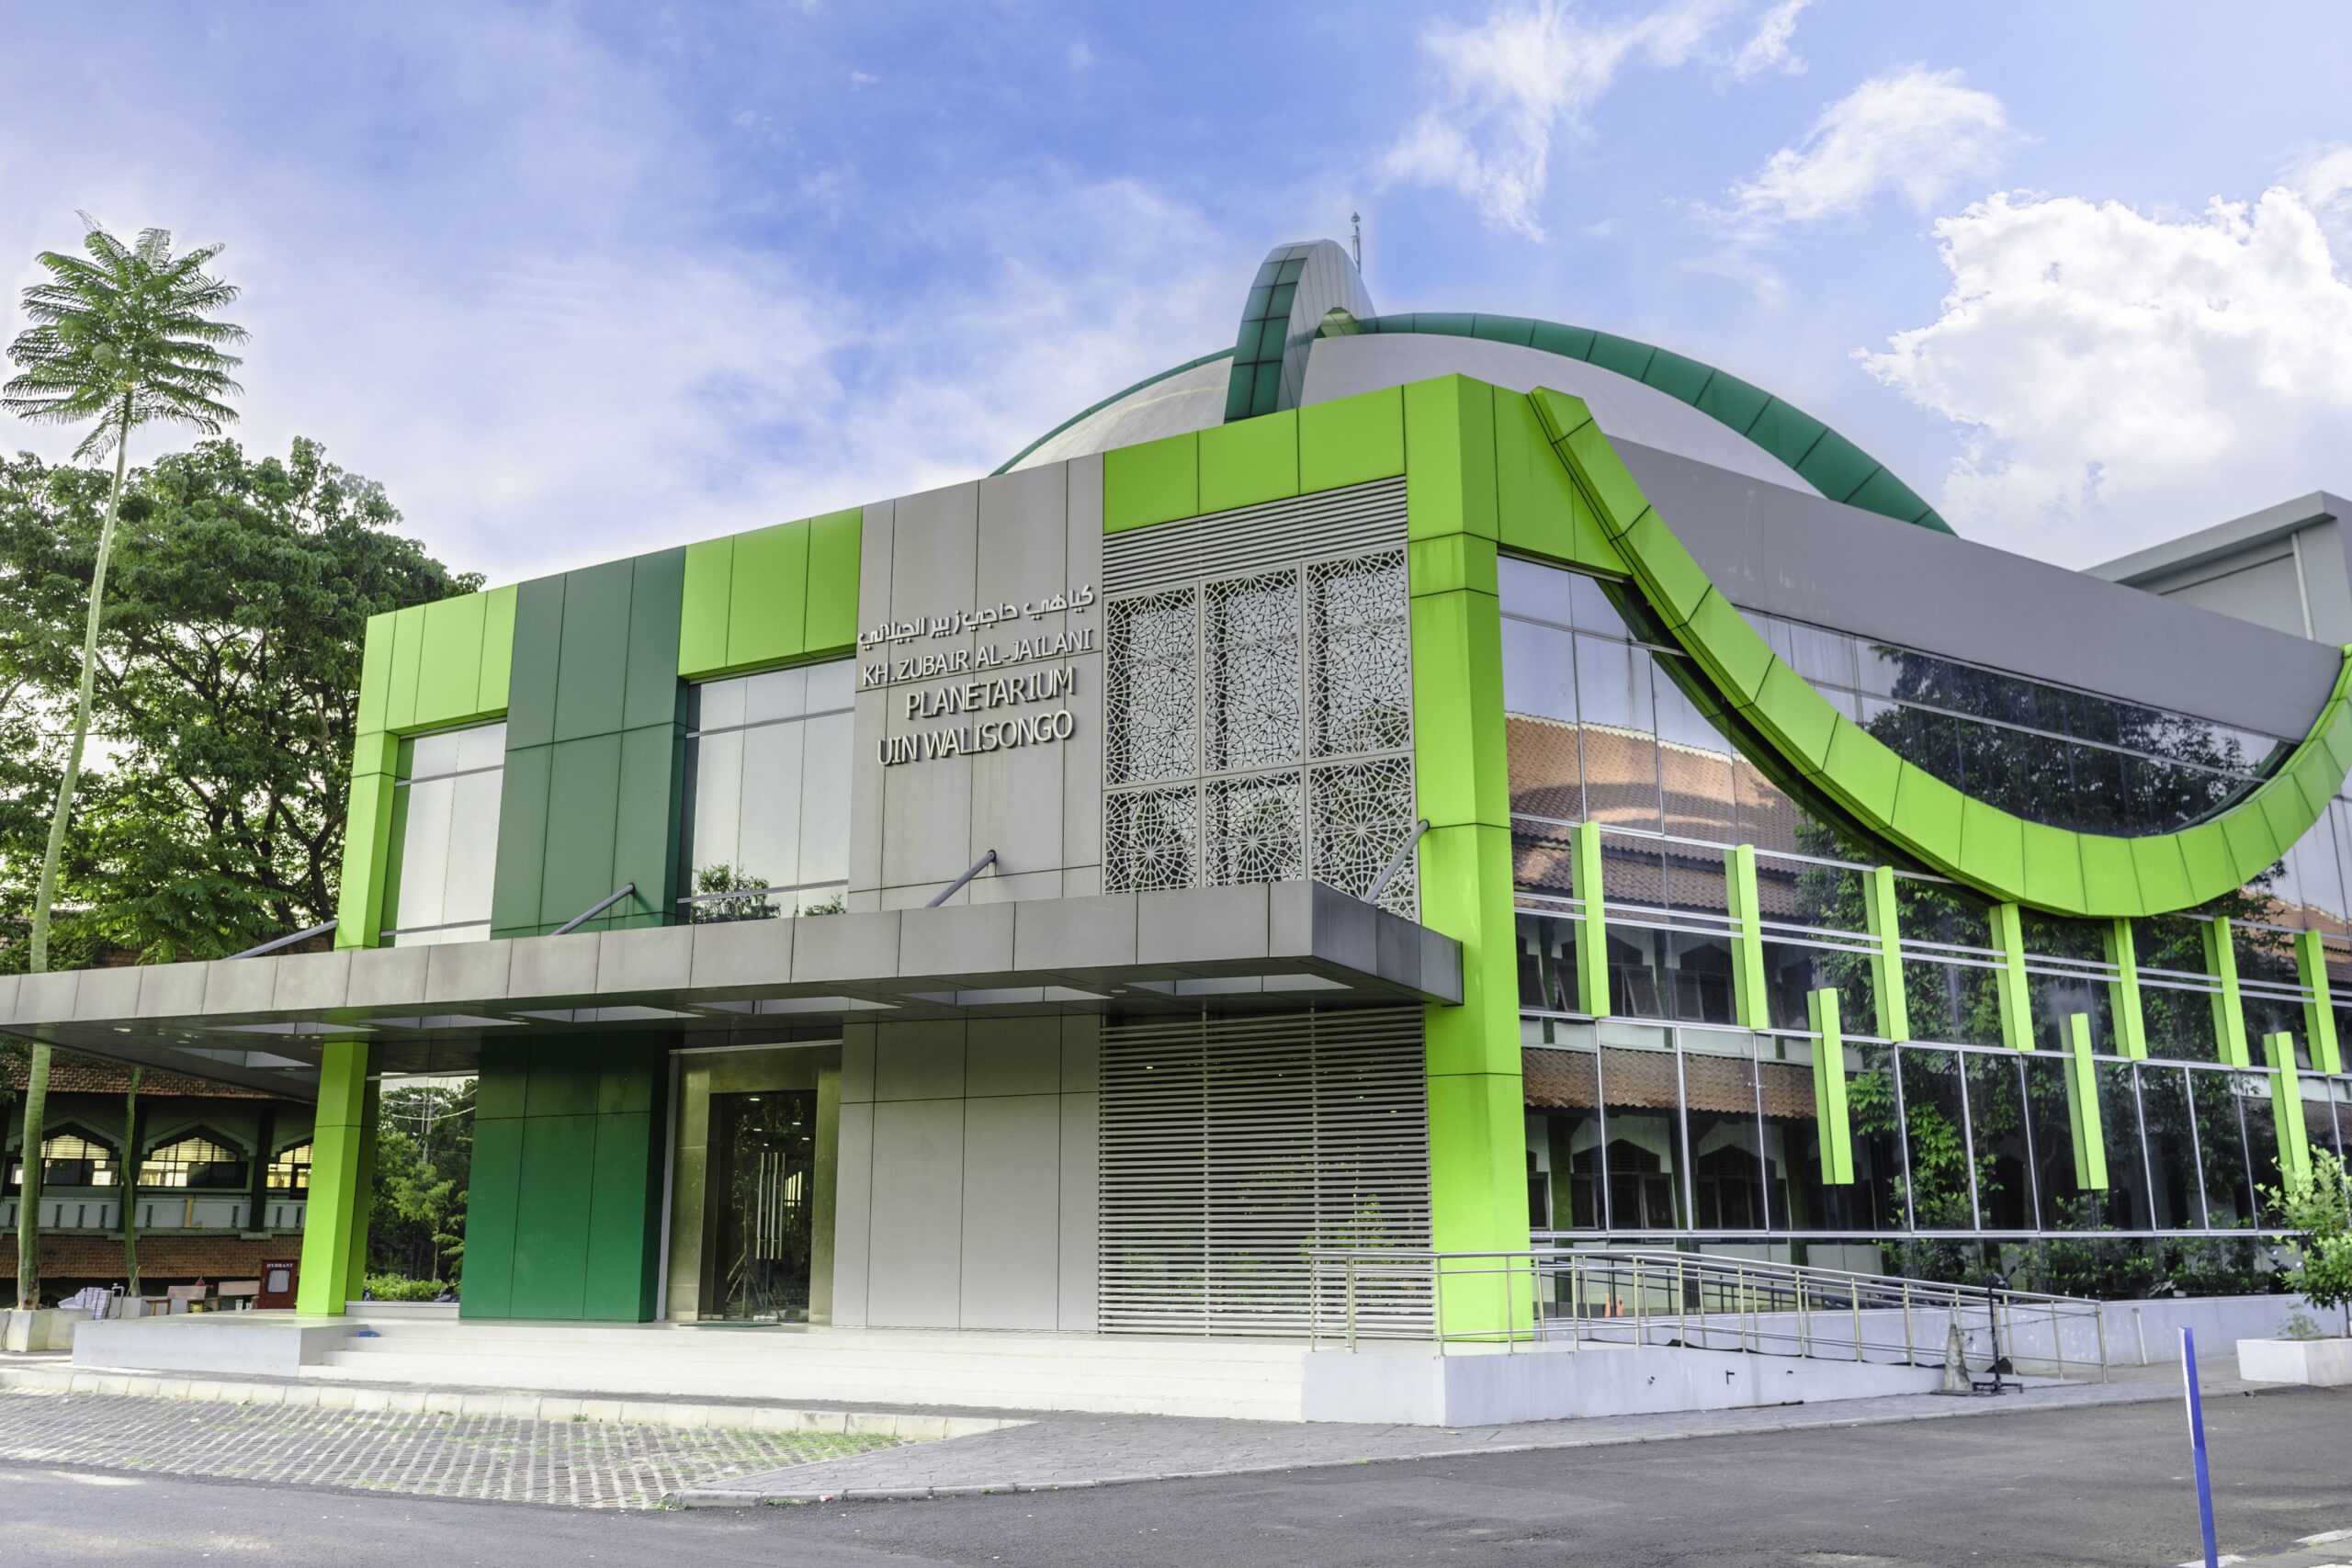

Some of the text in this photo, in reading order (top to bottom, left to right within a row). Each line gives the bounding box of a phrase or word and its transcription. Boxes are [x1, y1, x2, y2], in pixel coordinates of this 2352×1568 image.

[962, 602, 1019, 631] حاجي
[1023, 584, 1094, 620] كياهي
[976, 628, 1092, 669] AL-JAILANI
[906, 666, 1073, 719] PLANETARIUM
[877, 709, 1073, 766] UIN WALISONGO
